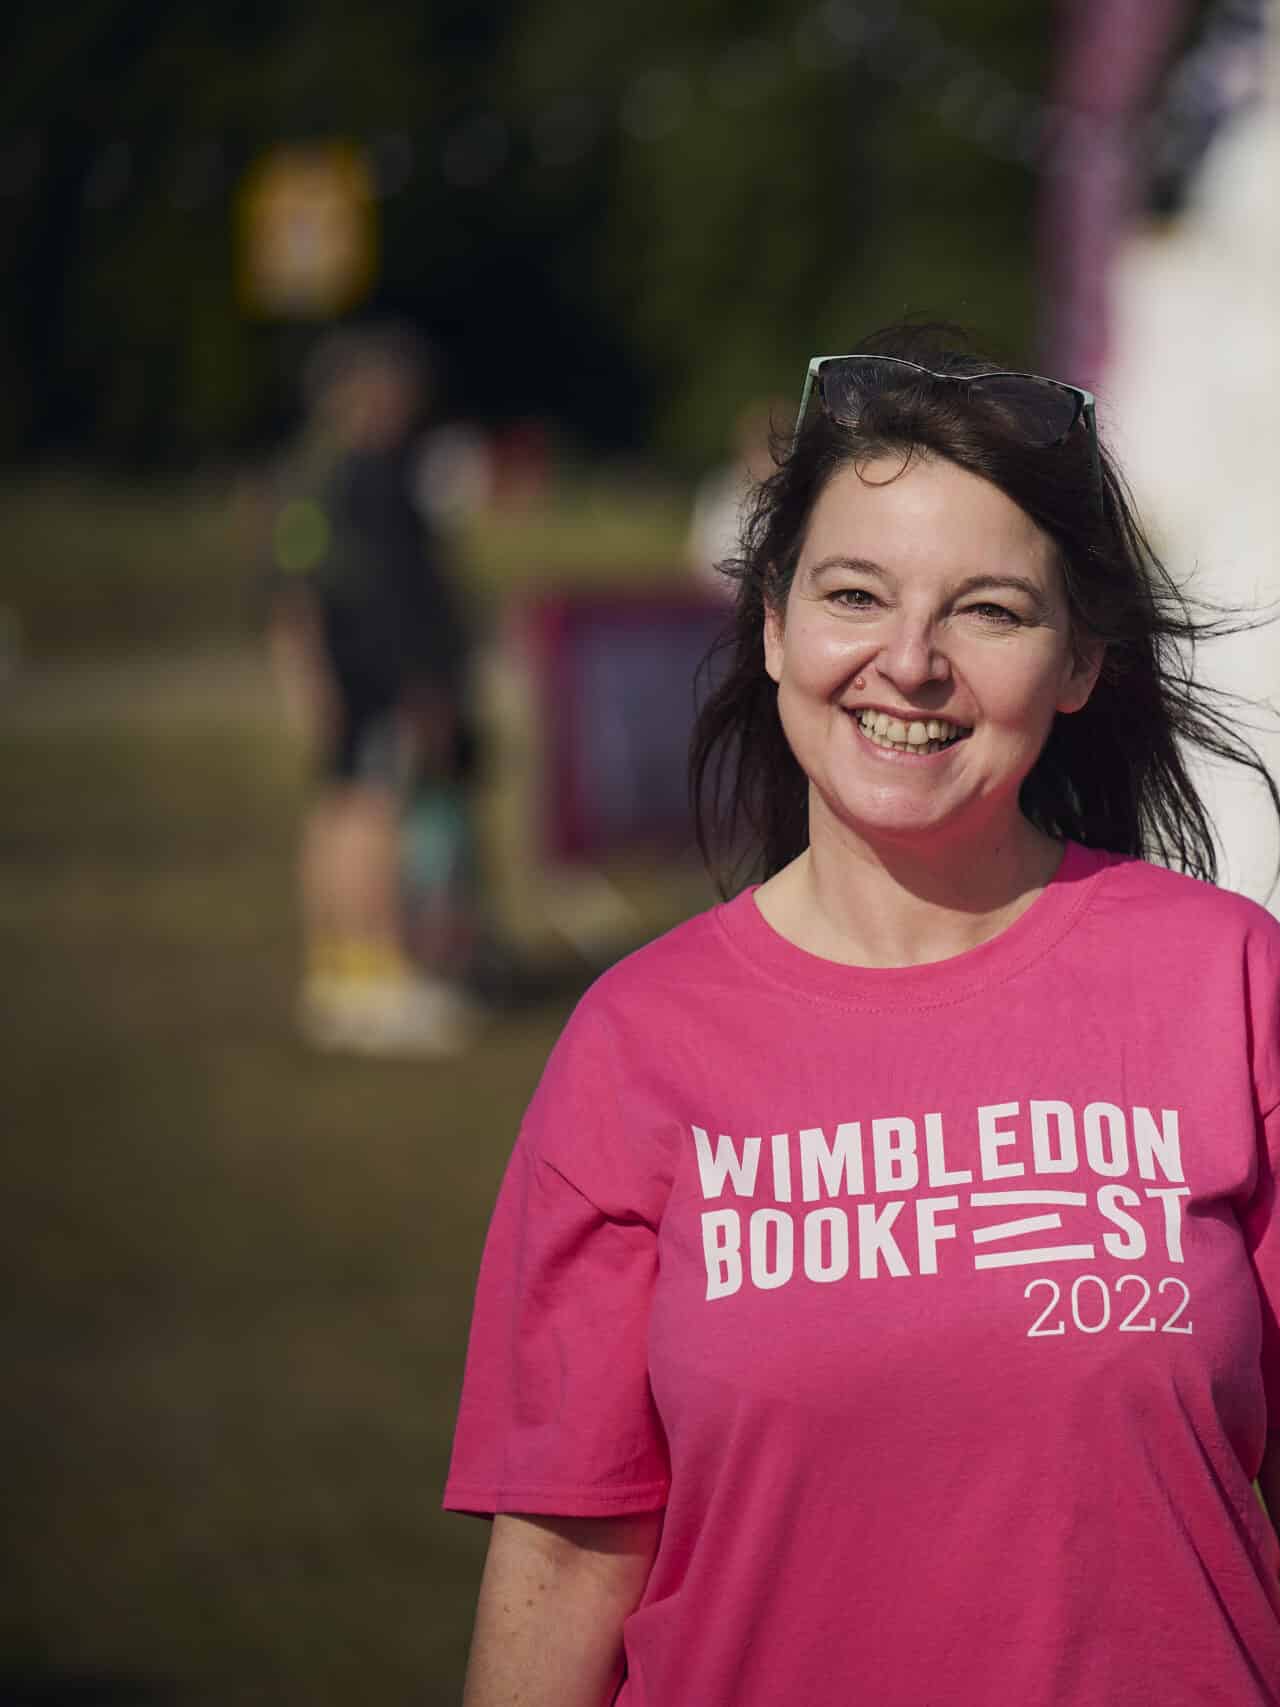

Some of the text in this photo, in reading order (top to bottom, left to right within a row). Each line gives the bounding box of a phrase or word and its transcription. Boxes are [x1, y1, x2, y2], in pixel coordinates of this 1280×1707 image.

[691, 1099, 1185, 1203] WIMBLEDON
[700, 1184, 1192, 1301] BOOKFEST
[1023, 1274, 1193, 1337] 2022
